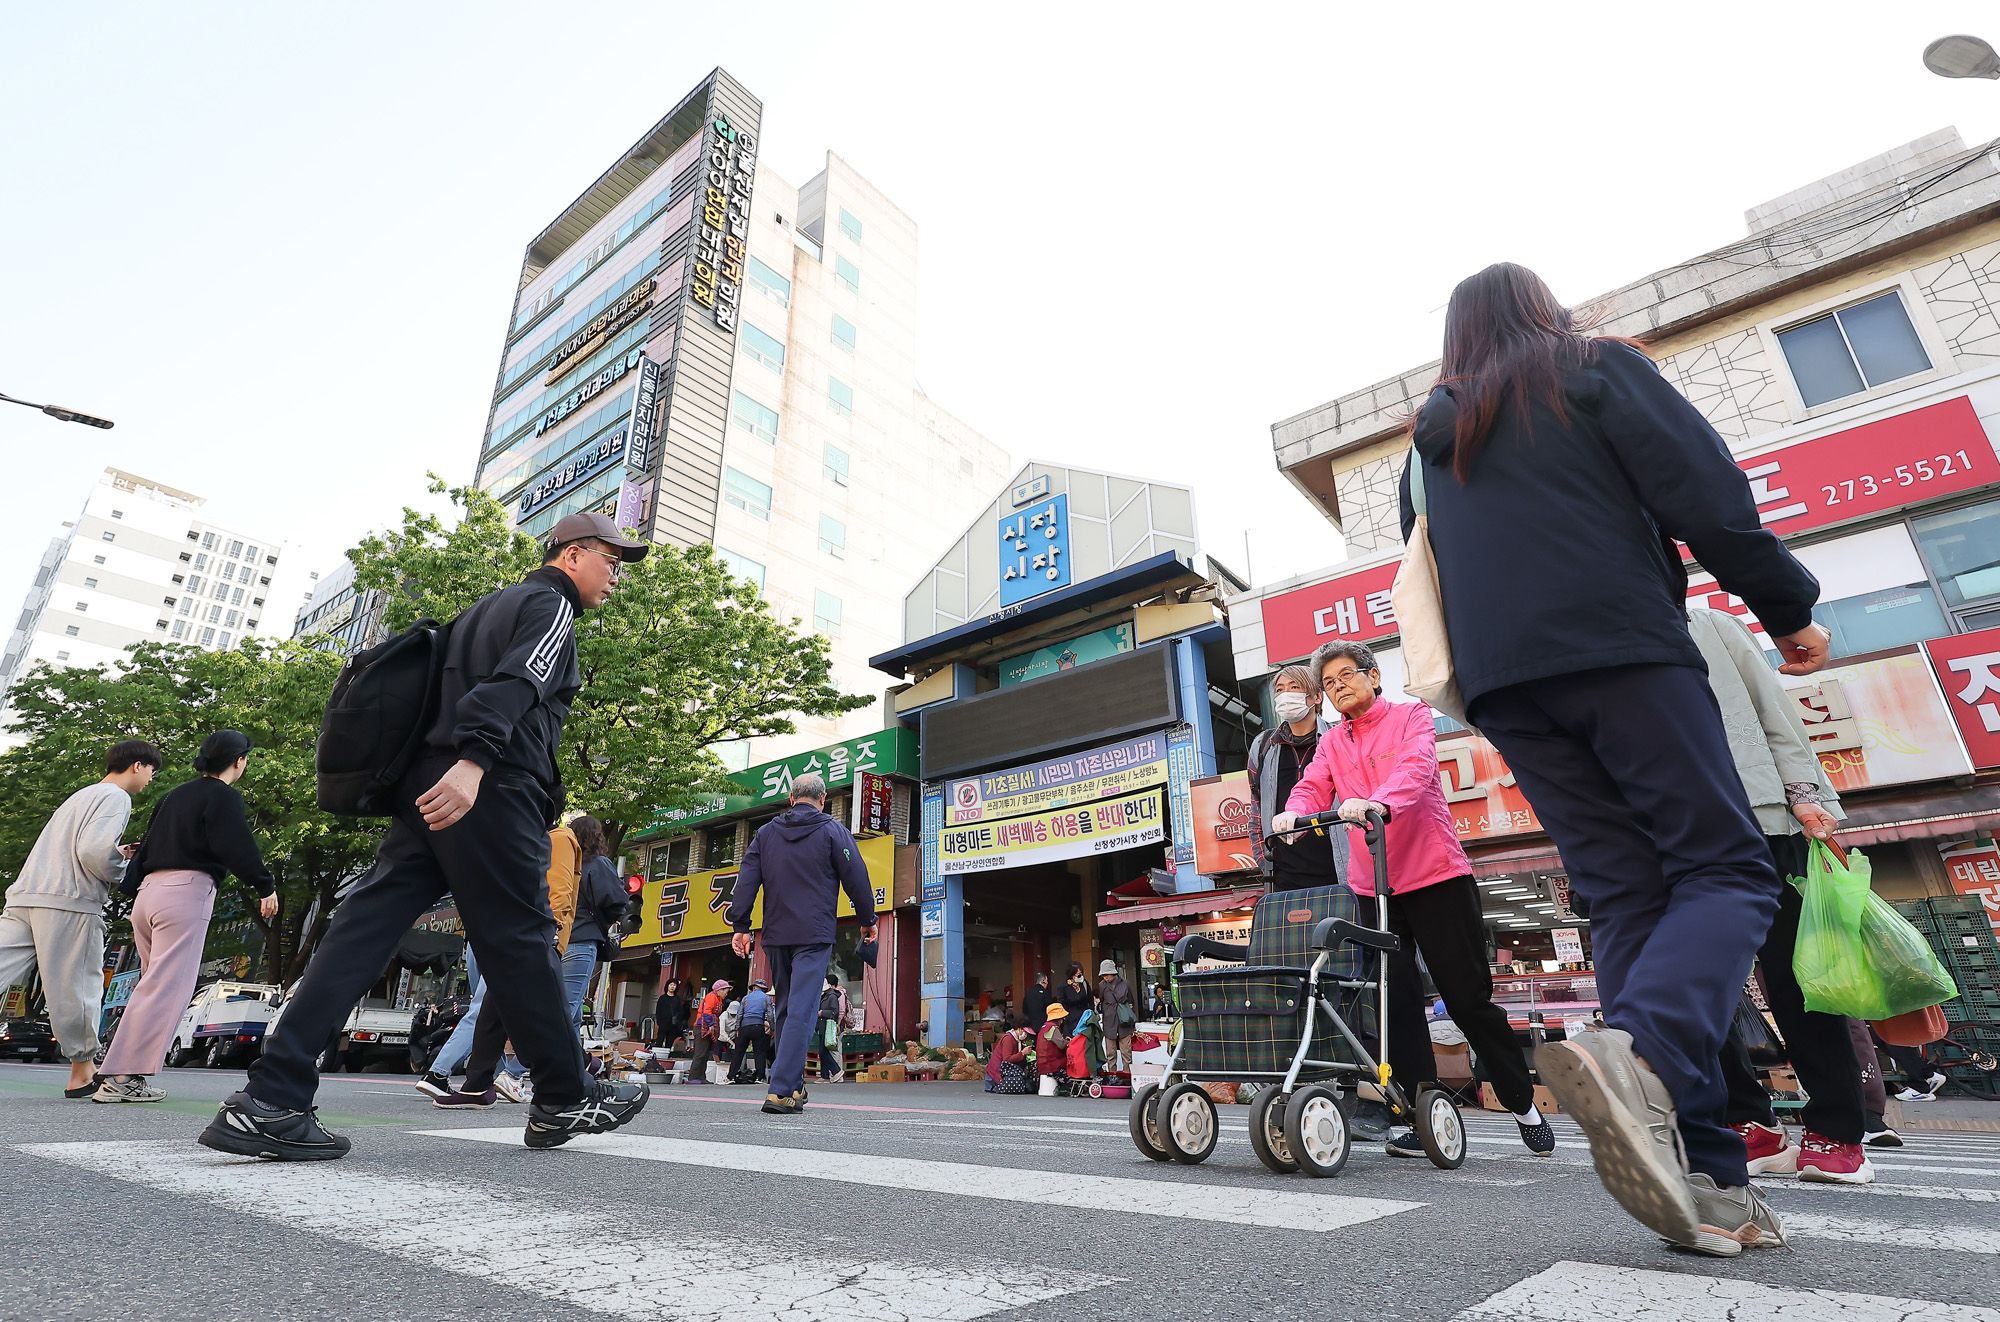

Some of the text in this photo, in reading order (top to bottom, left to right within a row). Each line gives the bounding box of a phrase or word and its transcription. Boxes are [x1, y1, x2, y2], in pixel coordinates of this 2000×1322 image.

[694, 136, 733, 309] 지아이연합내과의원
[716, 150, 756, 333] 울산제일안과의원
[557, 281, 650, 361] 지아이연합내과의원
[547, 356, 627, 427] 신종호치과의원
[630, 363, 658, 469] 신종호치과의원
[532, 431, 625, 506] 울산제일안과의원
[1018, 481, 1041, 498] 동문
[1821, 449, 1973, 506] 273-5521
[1002, 502, 1058, 552] 신정
[1003, 544, 1060, 581] 시장
[988, 605, 1023, 623] 신정시장
[1009, 621, 1134, 679] 신정상가시장 3
[984, 739, 1157, 796] 기초질서! 시민의 자존심입니다!
[986, 799, 1016, 812] 쓰레기투기
[1022, 789, 1064, 806] 광고물무단부착
[1070, 782, 1095, 796] 음주소란
[1101, 773, 1127, 788] 무전취식
[1133, 765, 1159, 781] 노상방뇨
[711, 796, 728, 812] 신발
[944, 828, 993, 854] 대형마트
[996, 820, 1048, 848] 새벽배송
[1050, 810, 1094, 839] 허용을
[1096, 796, 1158, 831] 반대한다!
[957, 810, 979, 821] NO
[1229, 803, 1251, 817] NAR
[1453, 809, 1533, 834] 산 신정점
[944, 855, 1006, 871] 울산남구상인연합회
[1094, 830, 1162, 851] 신정상가시장 상인회
